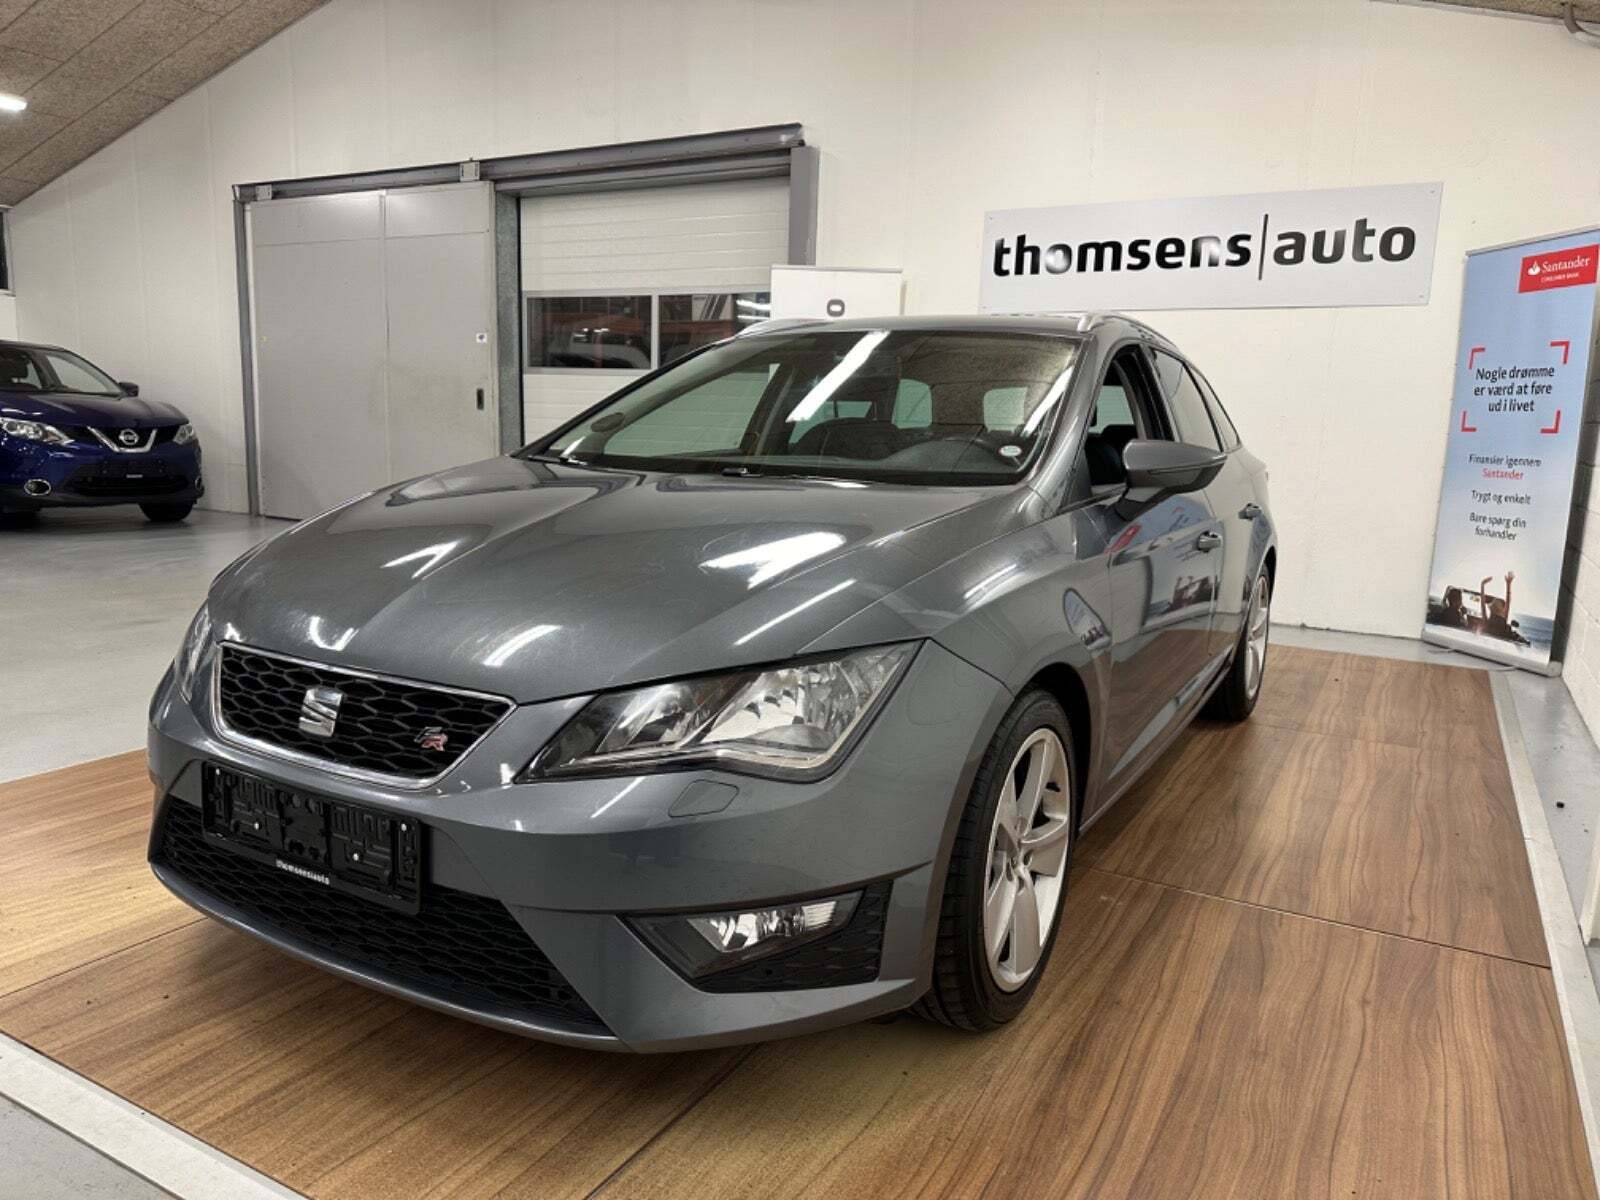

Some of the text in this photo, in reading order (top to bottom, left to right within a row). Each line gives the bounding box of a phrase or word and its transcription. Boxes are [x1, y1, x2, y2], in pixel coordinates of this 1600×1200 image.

[1542, 255, 1590, 273] Santander
[1476, 365, 1555, 383] Nogle drømme
[1474, 381, 1552, 396] er værd at føre
[1488, 399, 1502, 413] ud
[1509, 399, 1535, 413] livet
[1482, 467, 1524, 480] Santander
[1472, 489, 1531, 505] Trygt og enkelt
[1512, 517, 1527, 528] din
